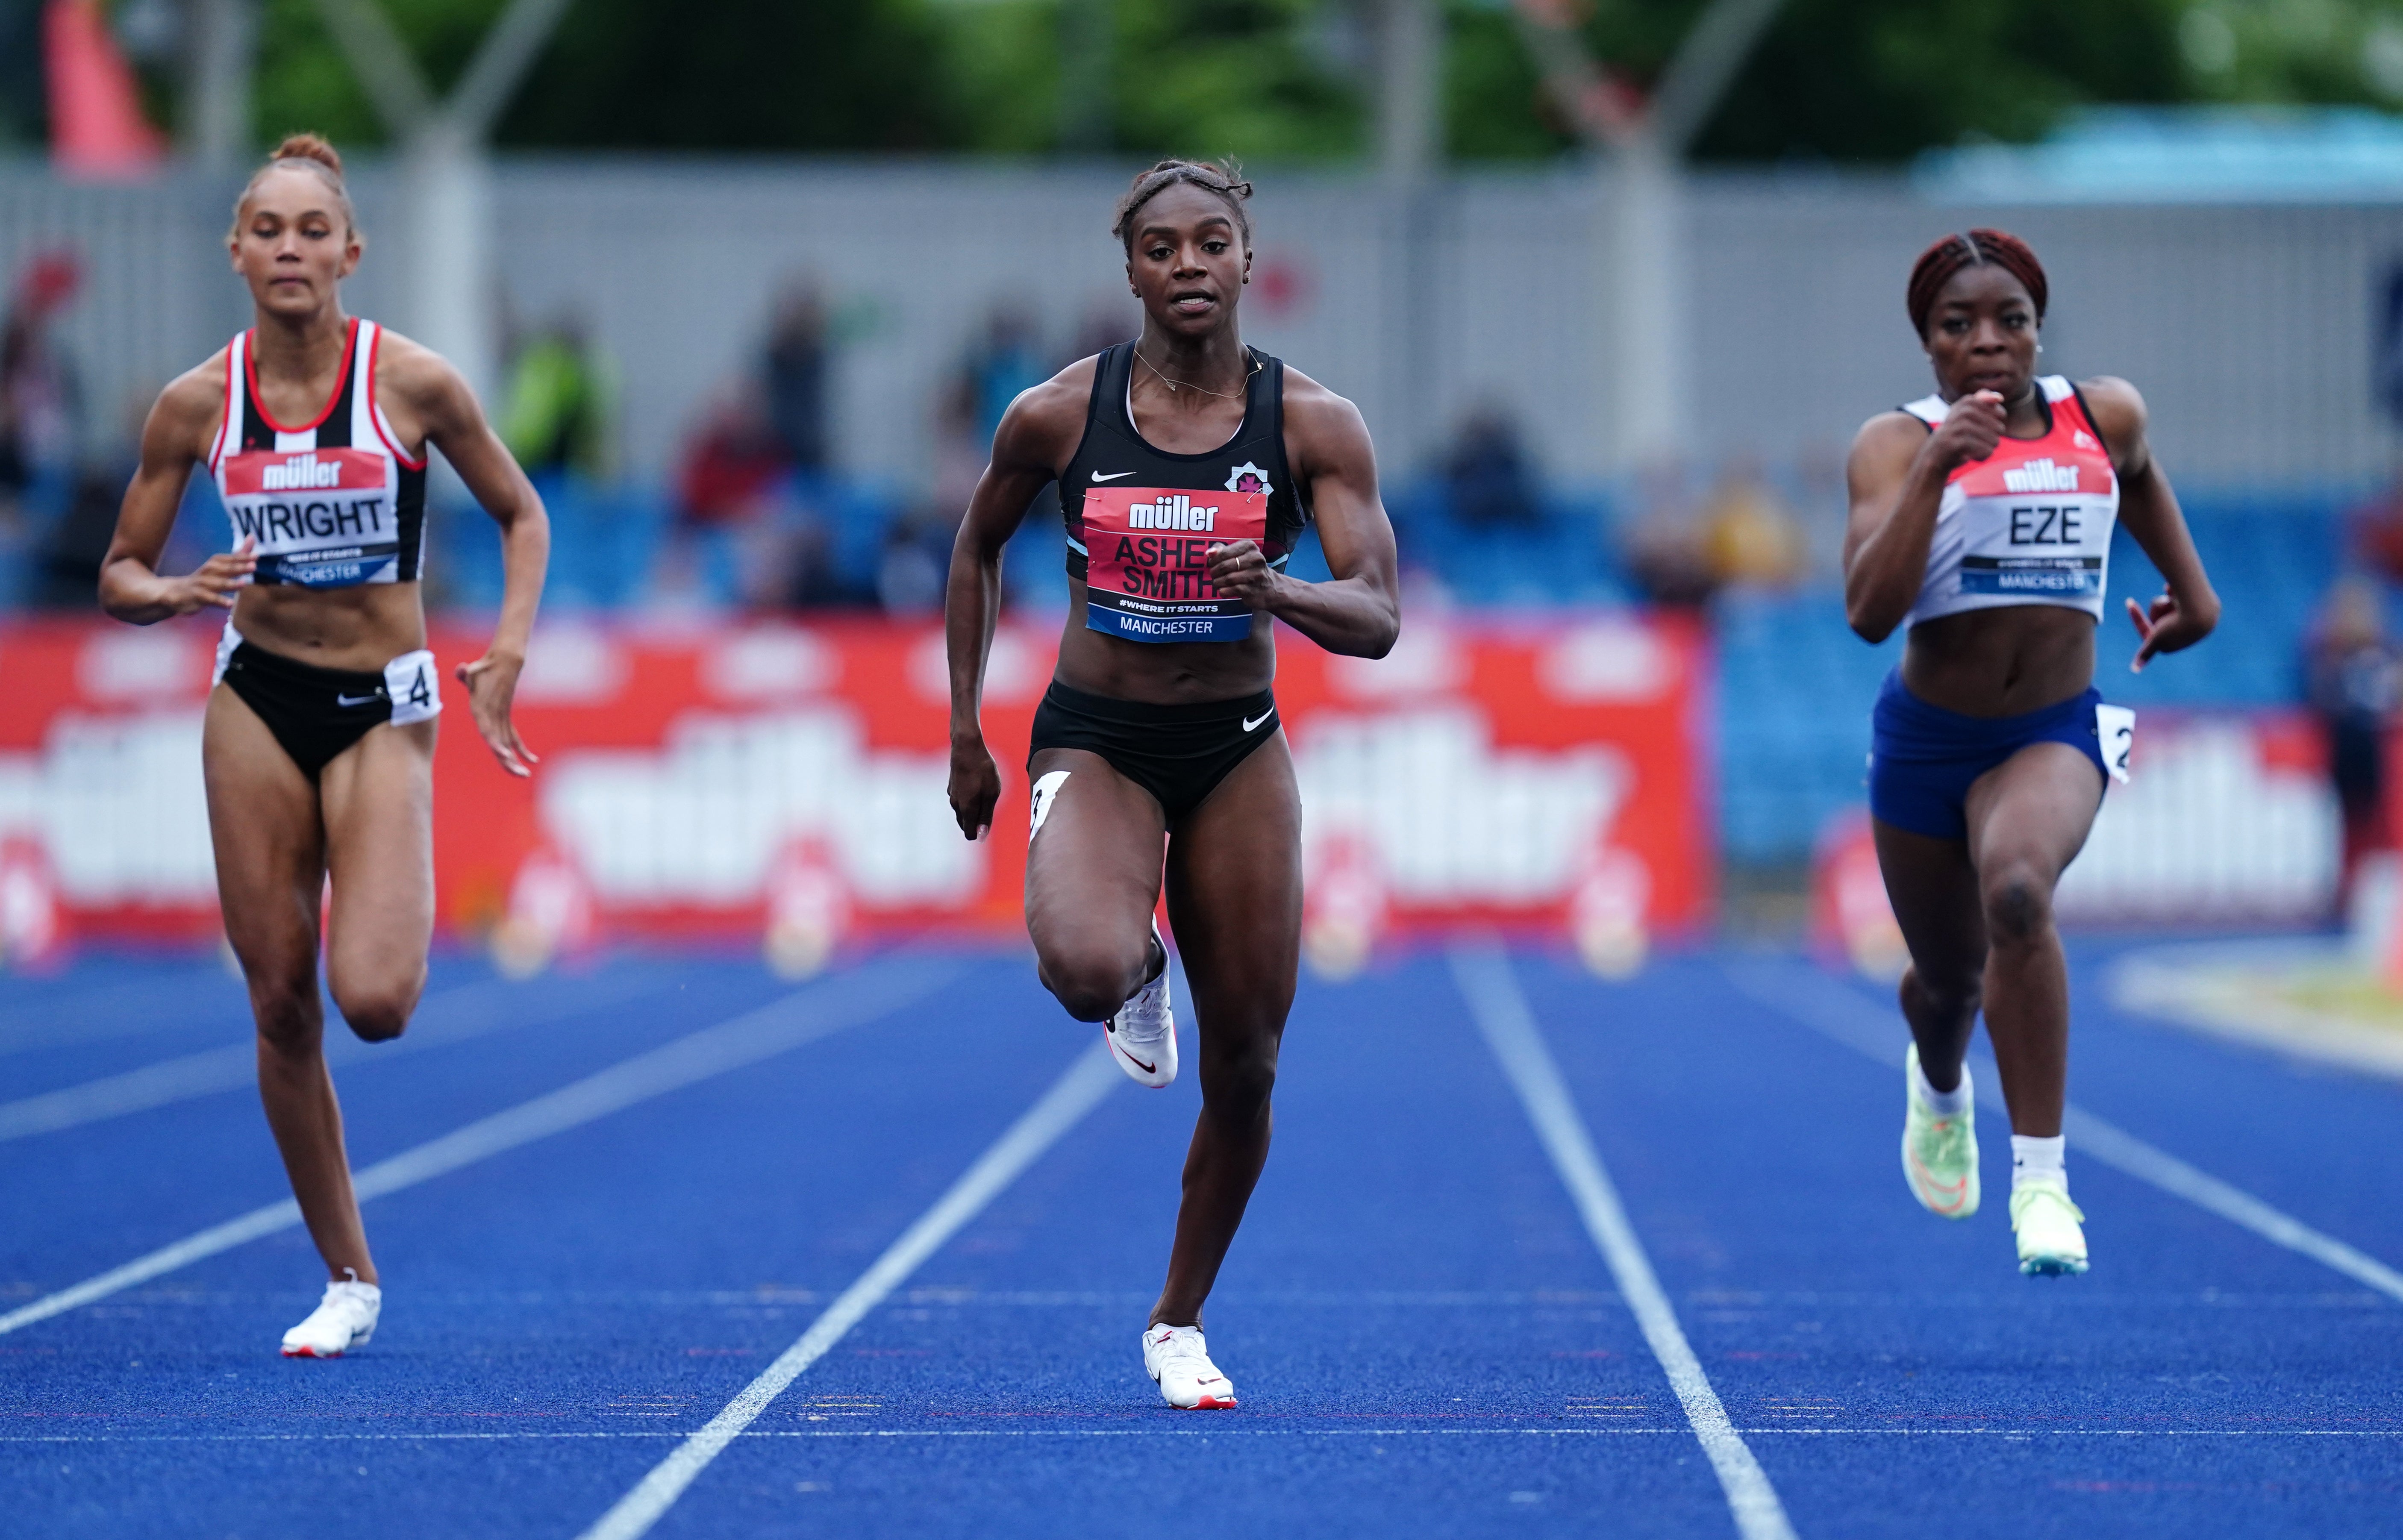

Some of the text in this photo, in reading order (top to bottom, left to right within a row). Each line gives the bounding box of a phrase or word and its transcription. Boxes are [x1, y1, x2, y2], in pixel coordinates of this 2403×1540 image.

[263, 453, 342, 490] müller
[2003, 457, 2079, 492] müller
[233, 499, 383, 544] WRIGHT
[1129, 494, 1219, 532] müller
[2010, 506, 2081, 545] EZE
[1123, 566, 1218, 599] SMITH
[1119, 599, 1165, 613] #WHERE
[1120, 616, 1213, 635] MANCHESTER
[410, 665, 430, 707] 4
[2117, 727, 2132, 768] 2
